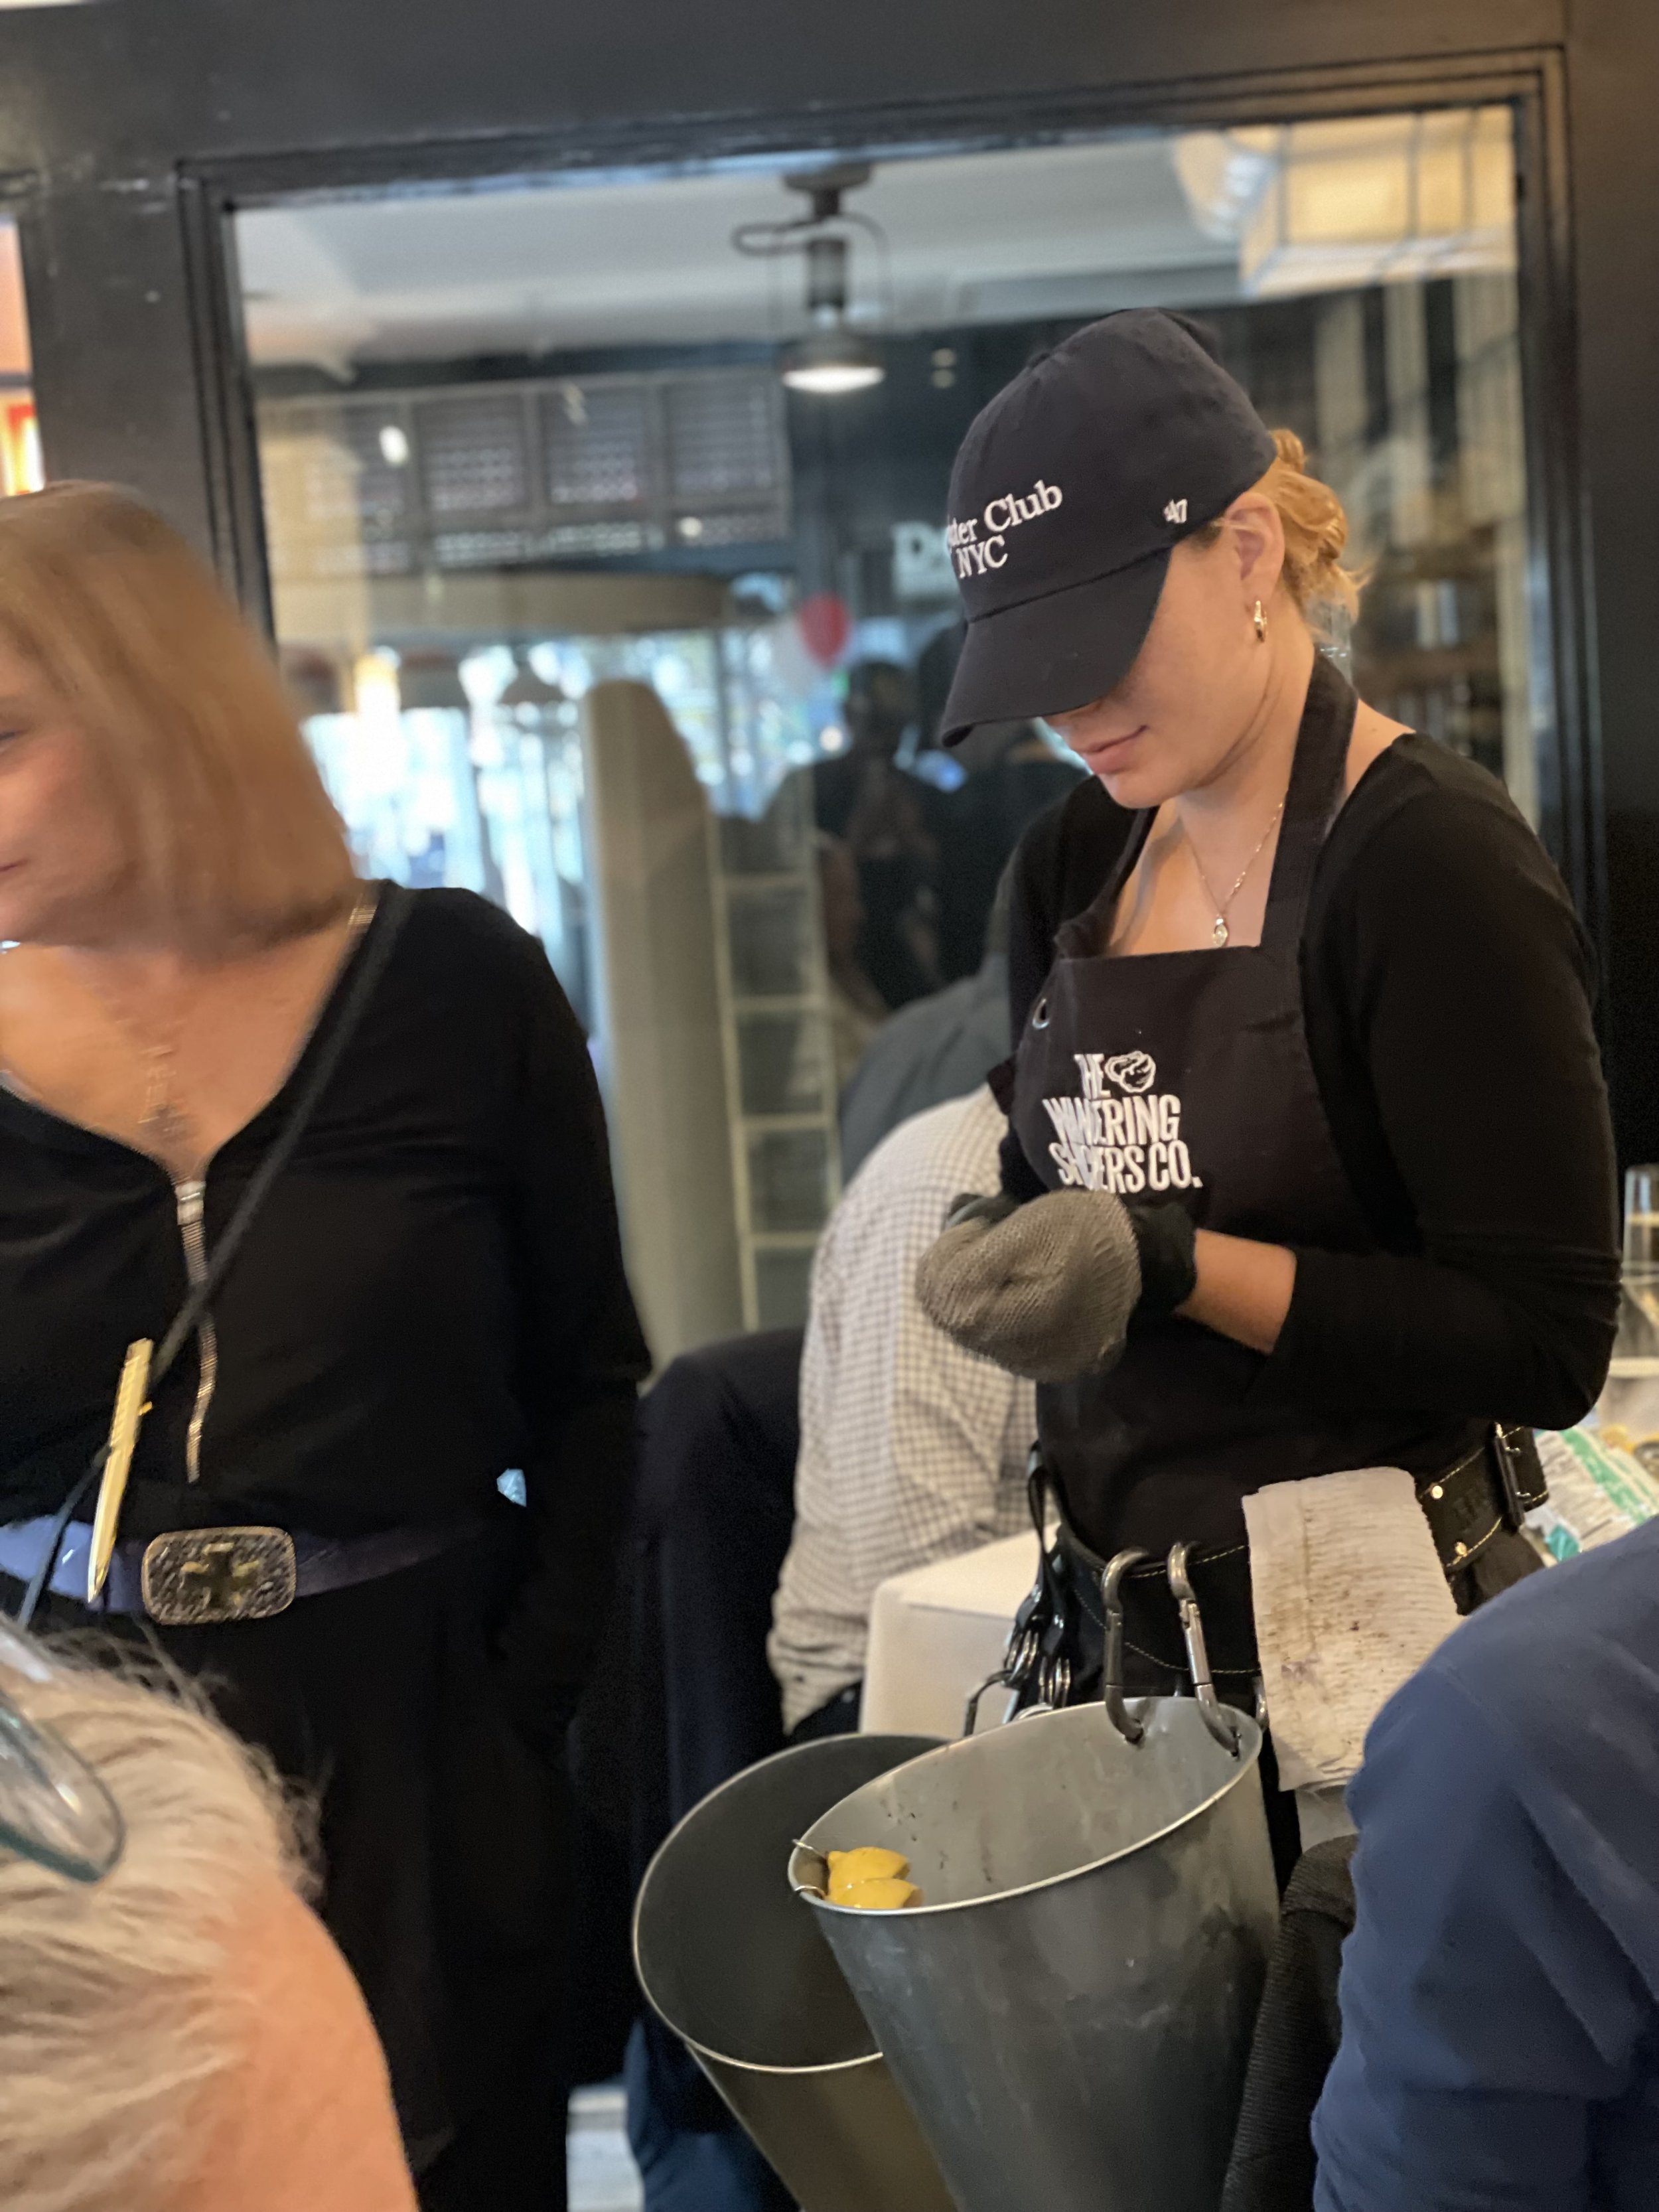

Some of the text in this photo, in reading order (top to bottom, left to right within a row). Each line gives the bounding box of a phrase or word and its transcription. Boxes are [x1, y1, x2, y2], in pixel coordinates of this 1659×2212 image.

[983, 479, 1063, 532] Club
[956, 534, 1008, 579] NYC
[1149, 1140, 1203, 1191] CO.
